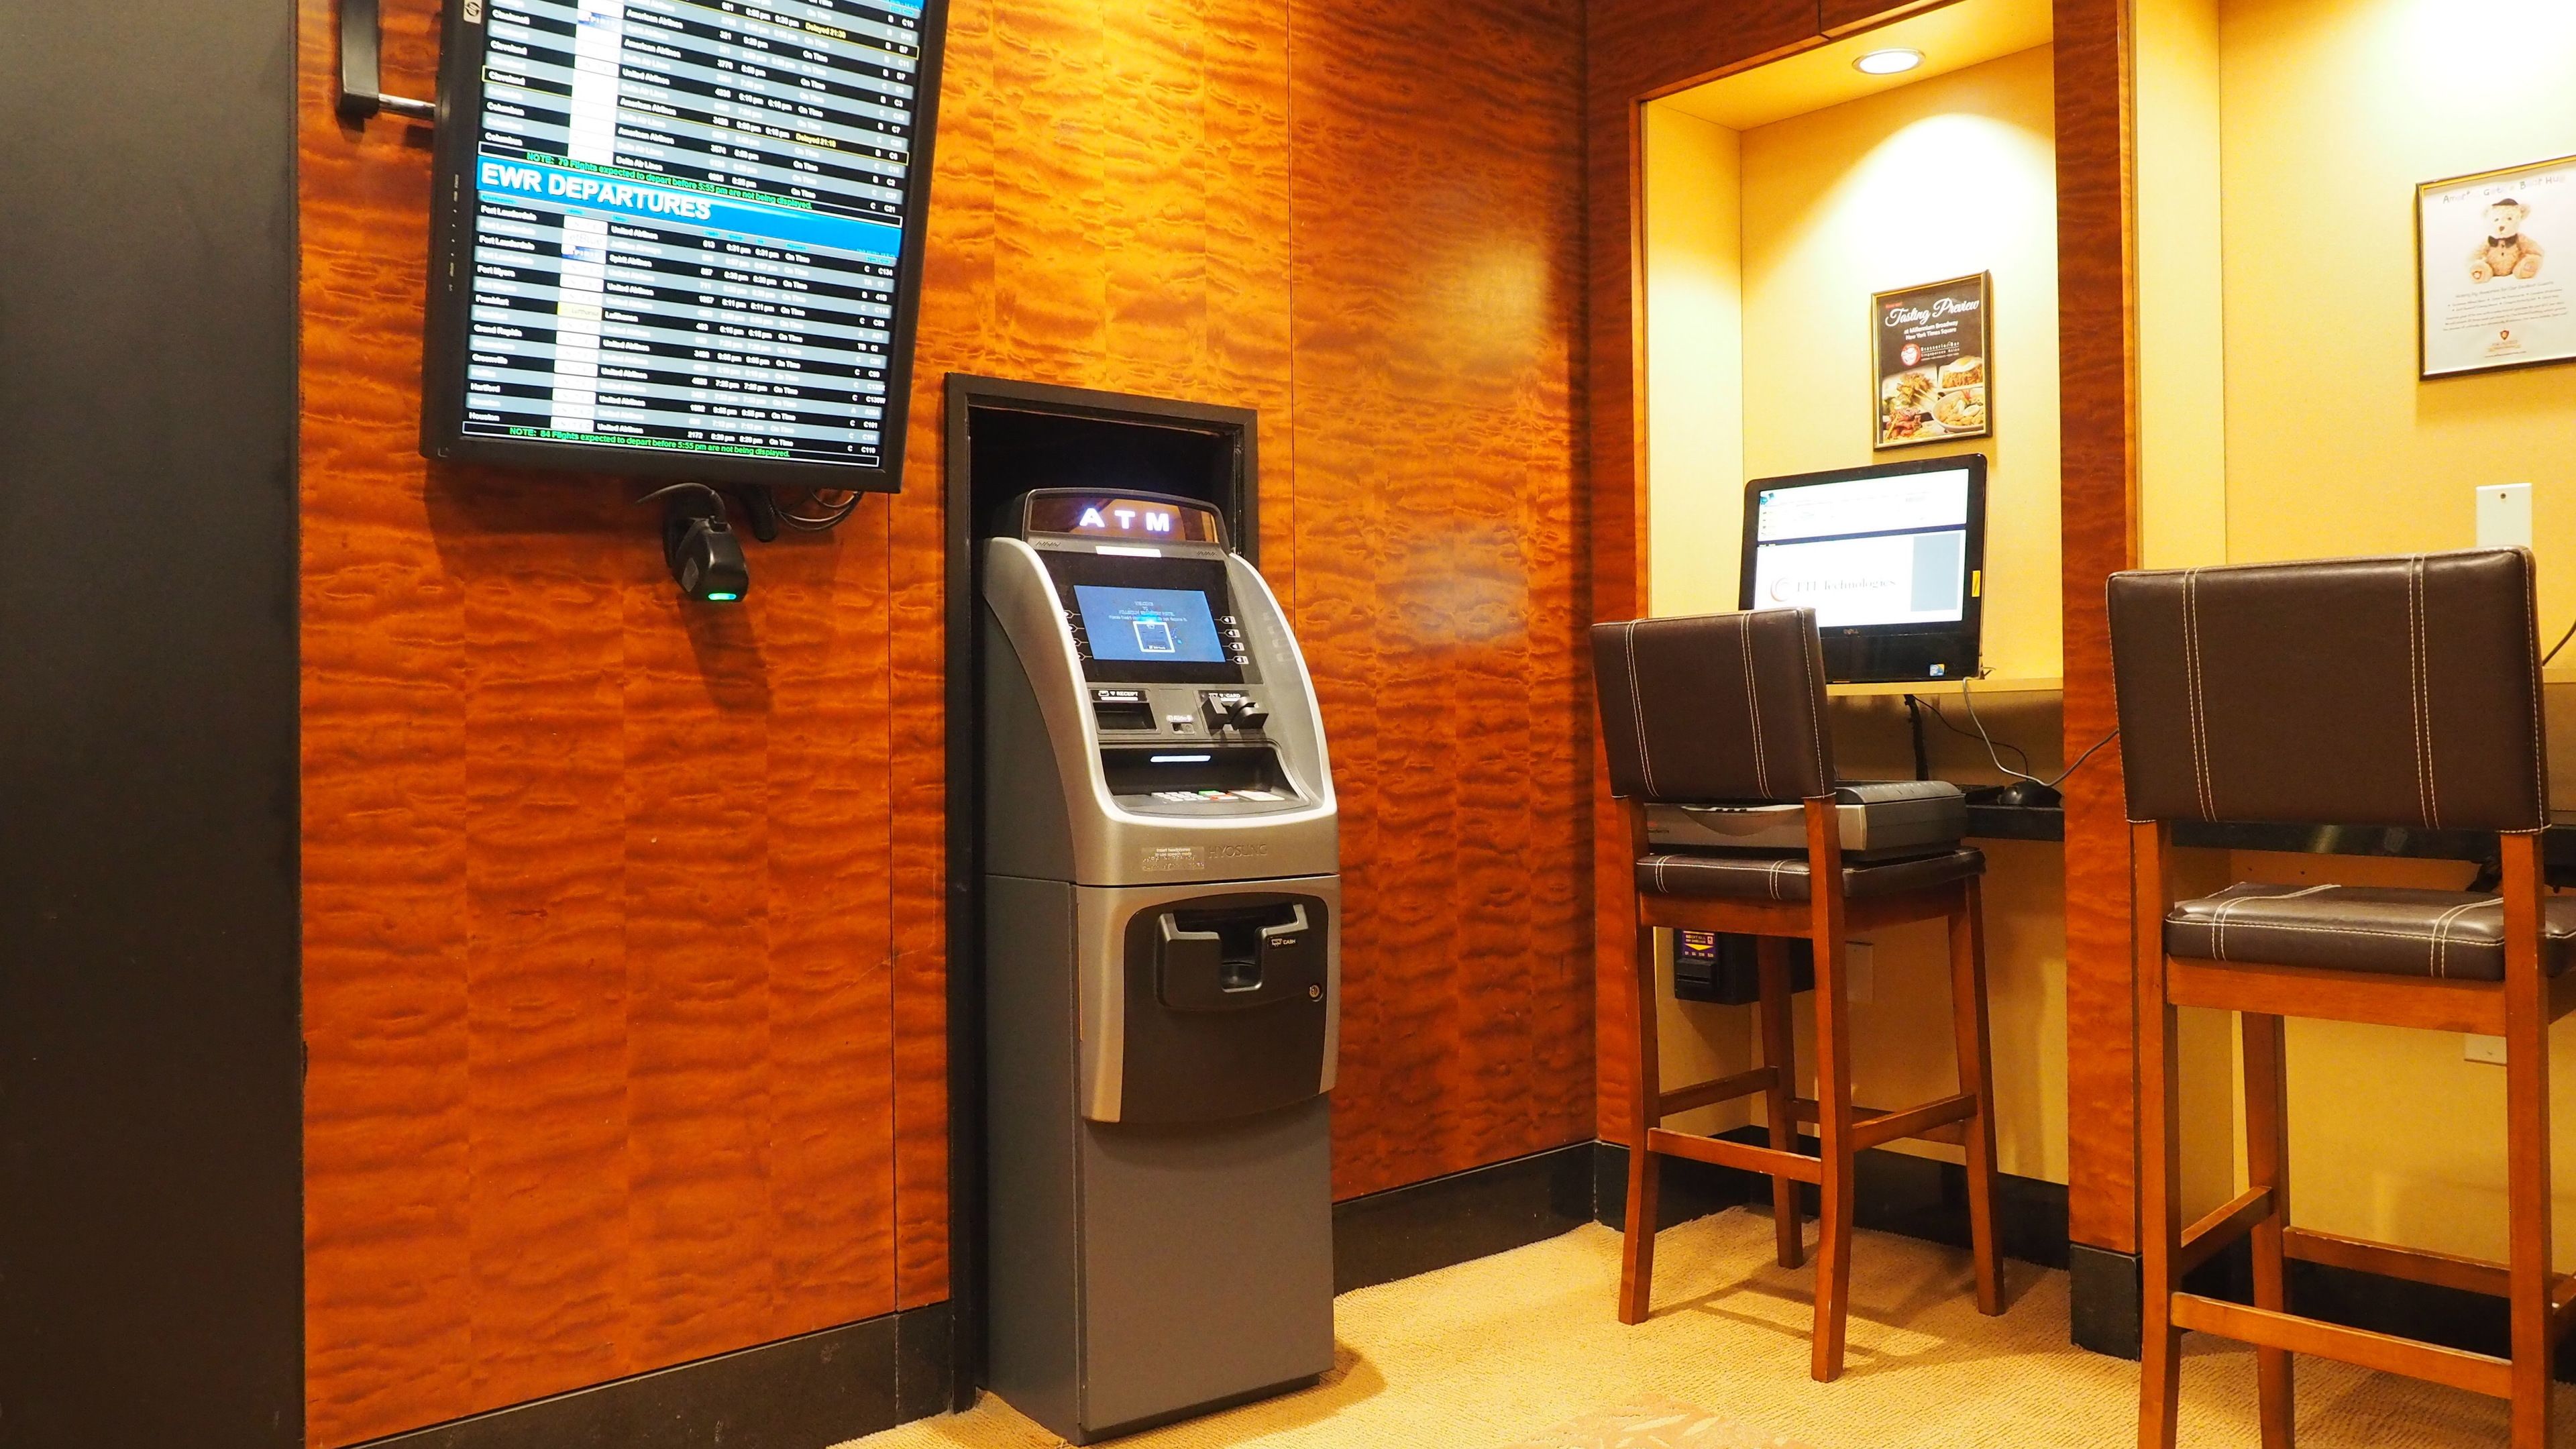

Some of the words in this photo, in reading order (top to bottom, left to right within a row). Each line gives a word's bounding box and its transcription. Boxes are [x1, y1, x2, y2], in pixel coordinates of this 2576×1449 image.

[627, 9, 658, 23] American
[658, 17, 683, 29] Airlines
[803, 50, 812, 59] On
[813, 52, 828, 62] Time
[490, 40, 527, 55] Cleveland
[623, 68, 645, 80] United
[645, 73, 669, 85] Airlines
[798, 106, 808, 114] On
[808, 108, 823, 117] Time
[625, 39, 656, 52] American
[656, 46, 681, 58] Airlines
[800, 78, 810, 87] On
[811, 80, 825, 90] Time
[489, 72, 525, 85] Cleveland
[620, 98, 652, 111] American
[652, 105, 676, 115] Airlines
[487, 102, 525, 116] Columbus
[618, 127, 650, 140] American
[650, 133, 674, 144] Airlines
[794, 160, 803, 168] On
[804, 162, 818, 172] Time
[485, 132, 523, 146] Columbus
[791, 188, 800, 196] On
[801, 190, 816, 199] Time
[527, 153, 554, 164] NOTE:
[557, 158, 570, 166] 79
[570, 160, 598, 172] Flights
[598, 166, 636, 178] expected
[646, 174, 672, 183] depart
[672, 178, 697, 189] before
[698, 183, 715, 192] 5:55
[755, 193, 776, 203] being
[777, 197, 812, 209] displayed.
[482, 163, 541, 192] EWR
[549, 174, 713, 219] DEPARTURES
[481, 205, 497, 215] Fort
[611, 225, 633, 235] United
[633, 229, 658, 239] Airlines
[786, 253, 795, 261] On
[796, 254, 810, 263] Time
[479, 235, 495, 244] Fort
[627, 257, 652, 267] Airlines
[793, 281, 808, 290] Time
[607, 283, 629, 292] United
[629, 286, 654, 296] Airlines
[791, 308, 805, 316] Time
[1885, 308, 1931, 327] Tasting
[1932, 298, 1980, 318] Preview
[603, 339, 625, 349] United
[625, 342, 649, 352] Airlines
[788, 334, 803, 342] Time
[471, 383, 500, 392] Hartford
[599, 396, 621, 404] United
[621, 398, 645, 407] Airlines
[601, 368, 623, 376] United
[623, 370, 647, 379] Airlines
[469, 412, 500, 421] Houston
[597, 423, 619, 431] United
[619, 425, 643, 433] Airlines
[510, 428, 535, 436] NOTE:
[551, 431, 579, 440] Flights
[580, 435, 616, 443] expected
[627, 437, 651, 445] depart
[755, 448, 789, 457] displayed.
[1079, 507, 1169, 532] ATM
